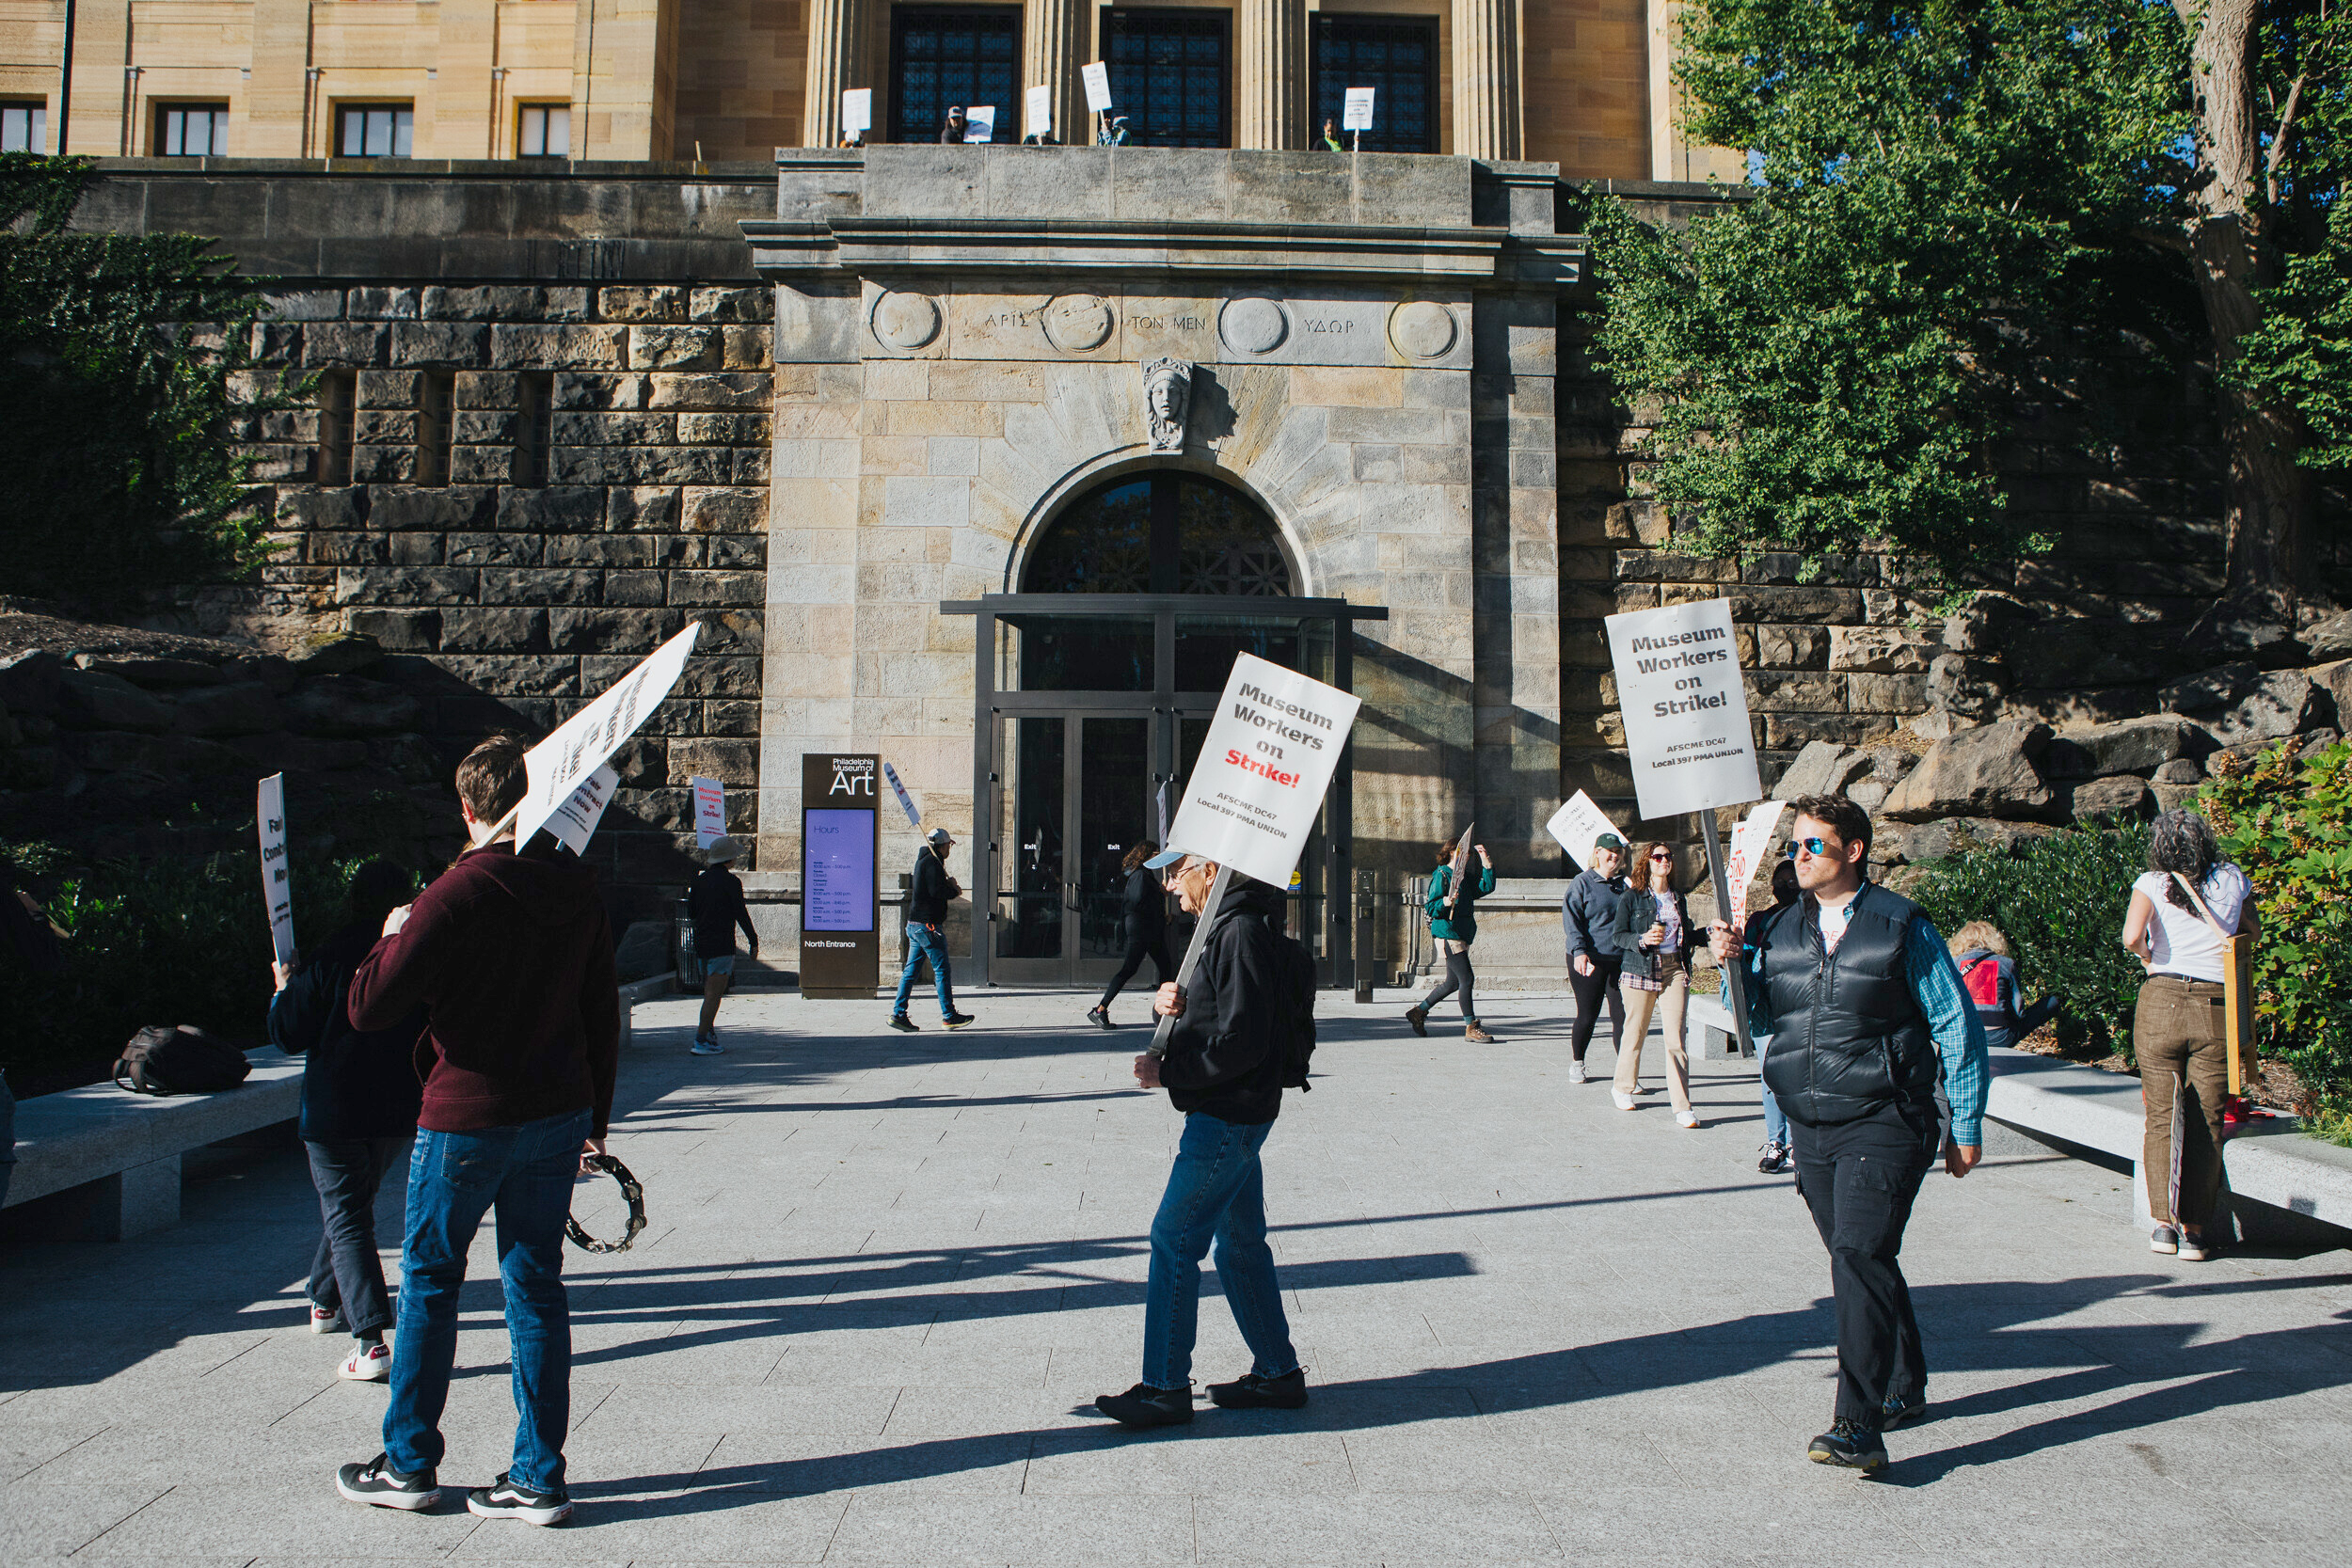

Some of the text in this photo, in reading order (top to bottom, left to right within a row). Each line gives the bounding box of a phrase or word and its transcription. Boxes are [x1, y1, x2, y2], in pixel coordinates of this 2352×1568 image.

[1304, 319, 1354, 333] ΥΔΩΡ
[1630, 626, 1726, 654] Museum
[1636, 648, 1728, 674] Workers
[1675, 676, 1702, 690] on
[1238, 682, 1333, 731] Museum
[1653, 690, 1727, 718] Strike!
[1233, 704, 1325, 752] Workers
[1256, 740, 1284, 760] on
[1666, 736, 1726, 753] AFSCME DC47
[833, 758, 874, 767] Philadelphia
[1652, 748, 1743, 768] Local 397 PMA UNION
[1225, 749, 1300, 788] Strike!
[828, 770, 874, 796] Art
[573, 796, 592, 814] Now
[576, 784, 603, 810] ontract
[1197, 797, 1287, 839] Local 397 PMA UNION
[1254, 806, 1278, 820] DC47
[268, 816, 284, 834] Fai
[814, 826, 840, 834] Hours
[274, 868, 288, 884] No
